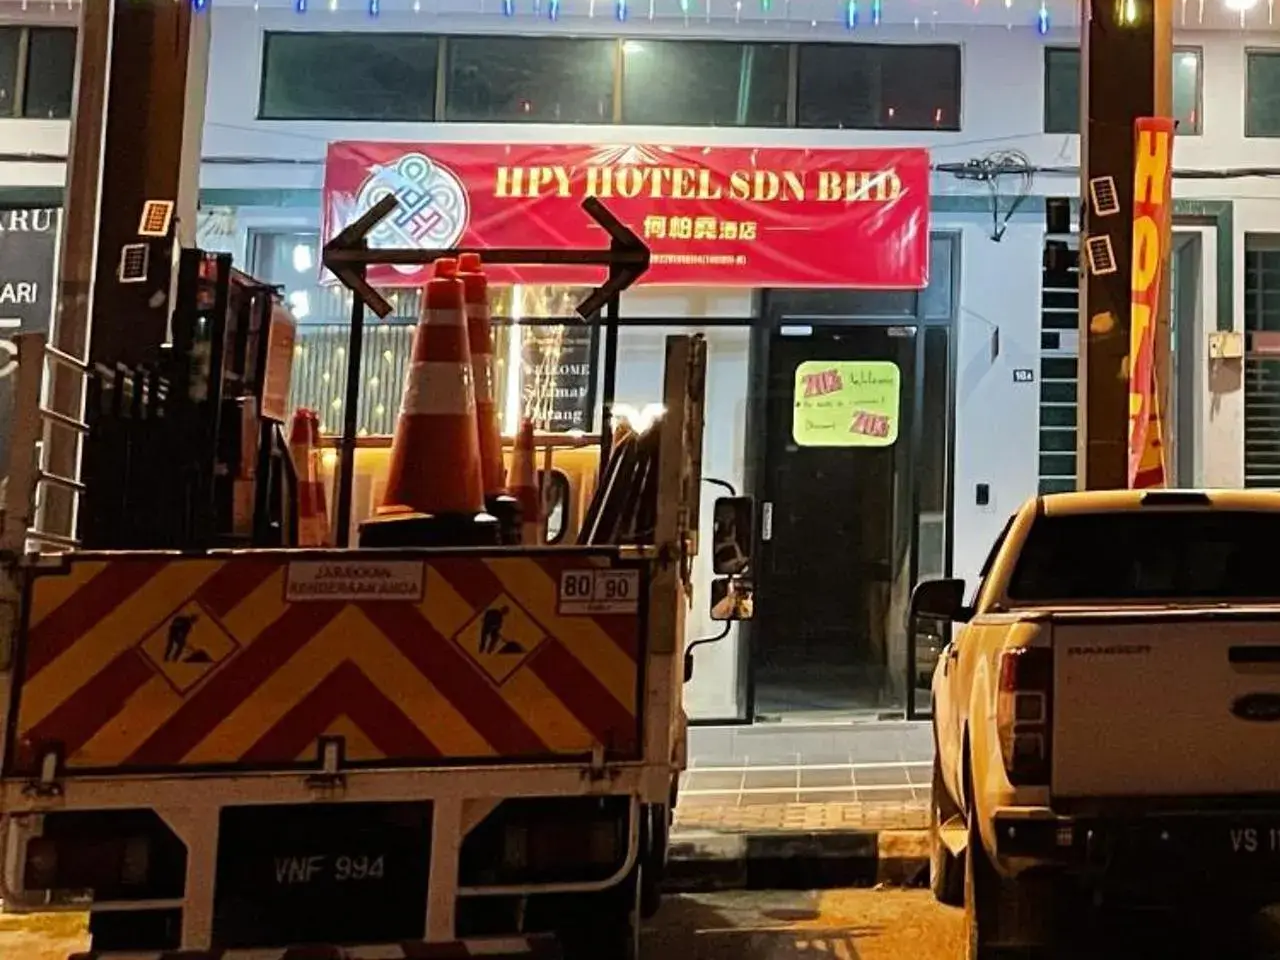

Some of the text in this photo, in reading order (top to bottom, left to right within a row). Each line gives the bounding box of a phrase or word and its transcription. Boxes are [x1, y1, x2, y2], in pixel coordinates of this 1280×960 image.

[493, 166, 903, 203] HPY HOTEL SDN BHD
[0, 208, 53, 232] RU
[564, 575, 629, 598] 80 90
[1229, 827, 1259, 853] VS
[333, 853, 388, 882] 994
